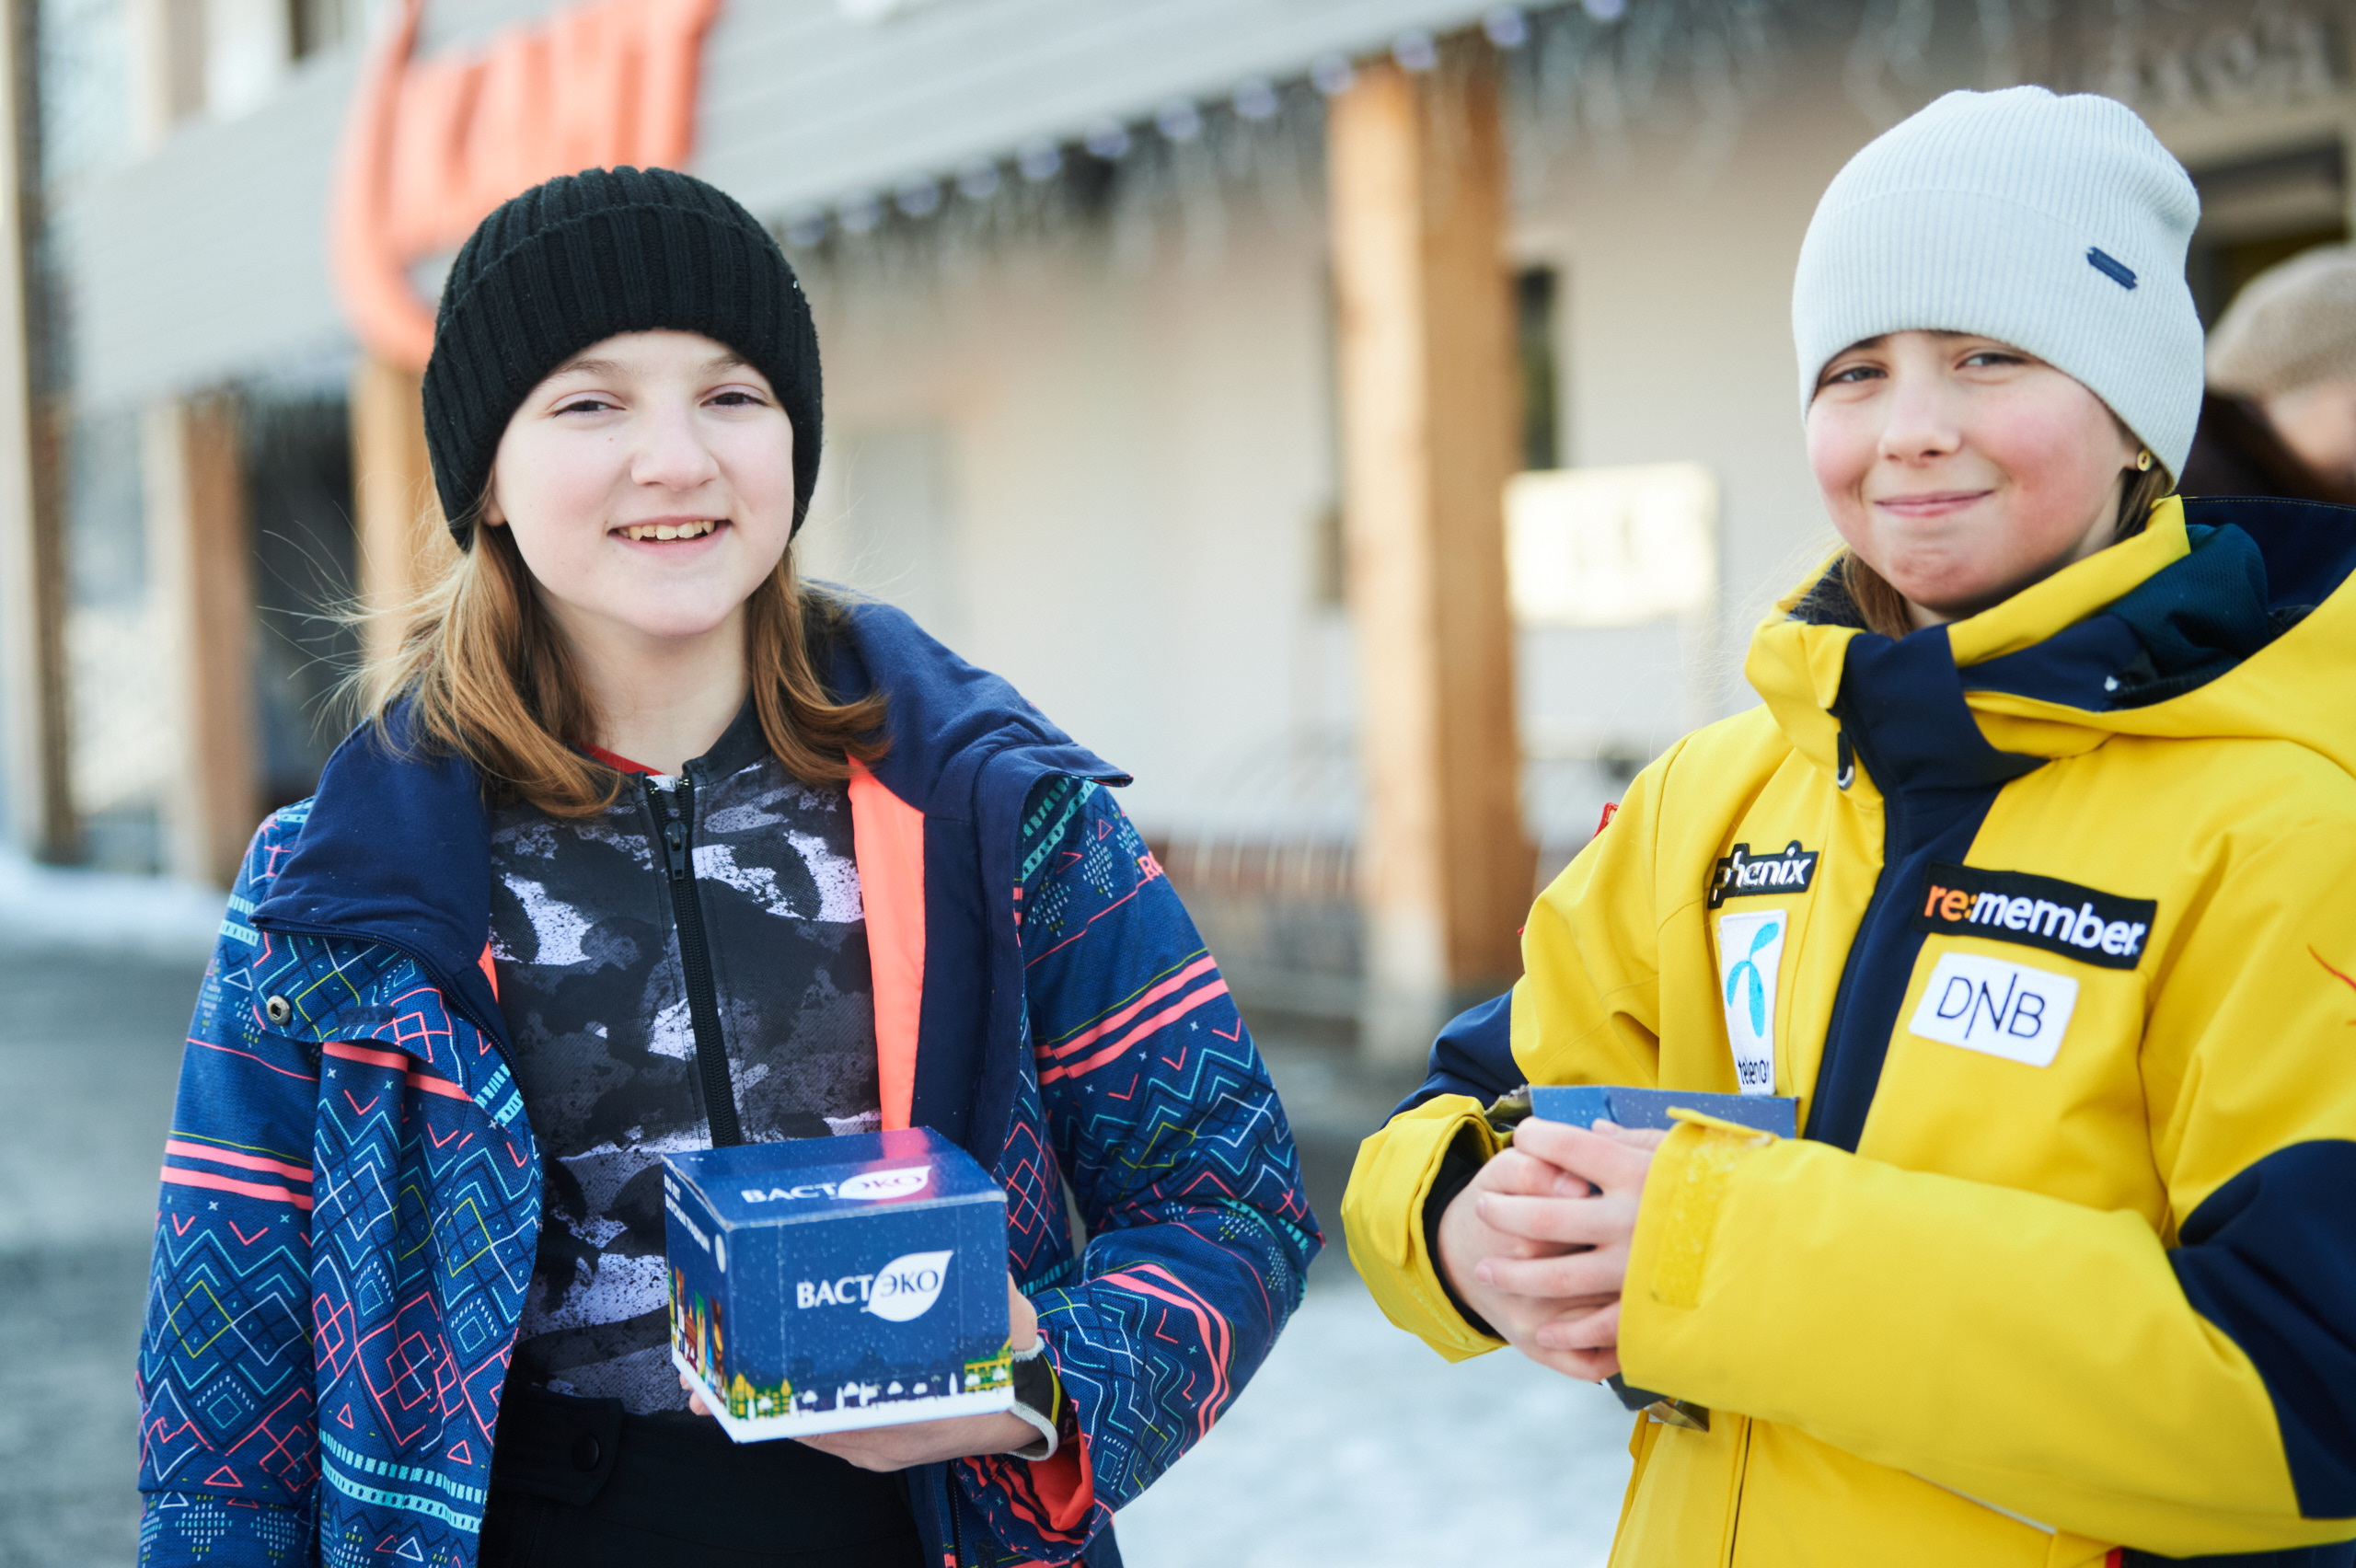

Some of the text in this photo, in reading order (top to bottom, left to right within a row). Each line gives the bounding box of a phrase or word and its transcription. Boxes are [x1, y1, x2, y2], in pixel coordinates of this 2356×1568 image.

[1713, 847, 1812, 902] phenix
[1923, 885, 2147, 956] re:member
[1936, 973, 2045, 1040] DNB
